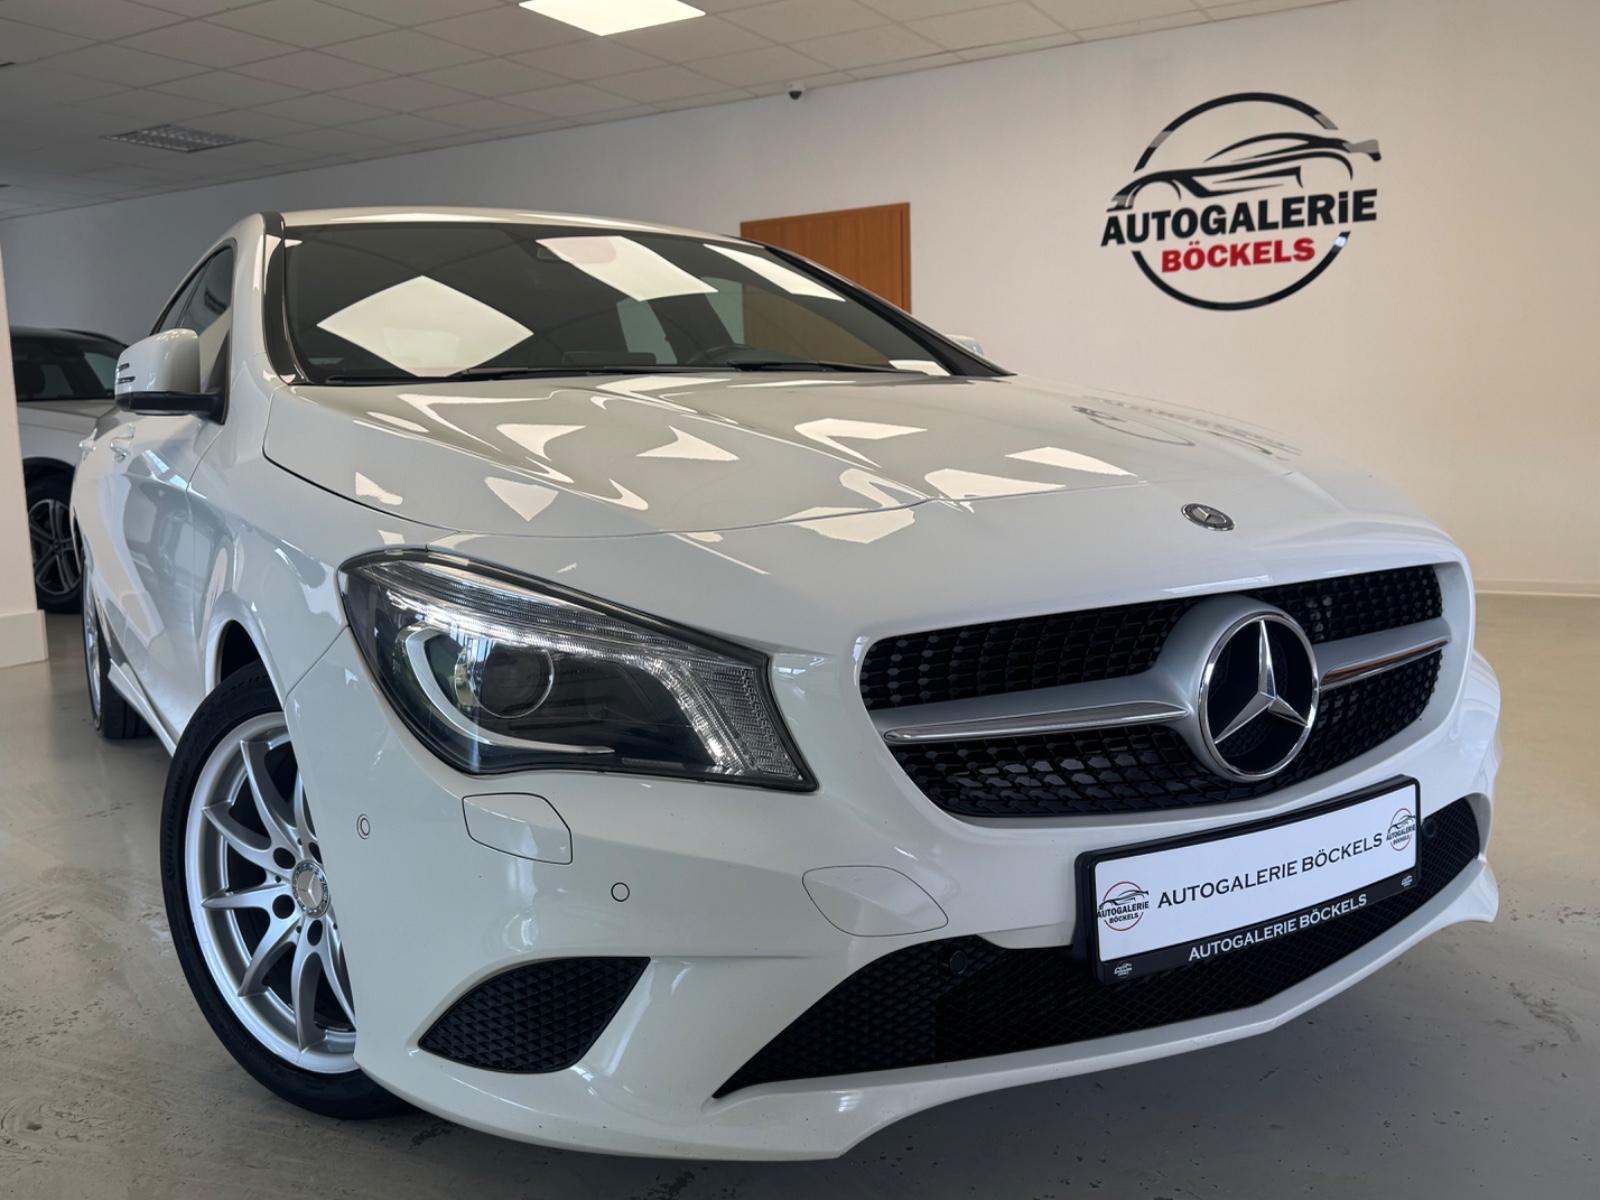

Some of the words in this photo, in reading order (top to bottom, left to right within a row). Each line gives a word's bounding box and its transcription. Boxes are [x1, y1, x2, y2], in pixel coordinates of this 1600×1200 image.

[1161, 237, 1316, 273] BÖCKELS
[1157, 860, 1298, 909] AUTOGALERIE
[1301, 832, 1383, 873] BÖCKELS
[1189, 918, 1297, 962] AUTOGALERIE
[1299, 893, 1368, 929] BÖCKELS
